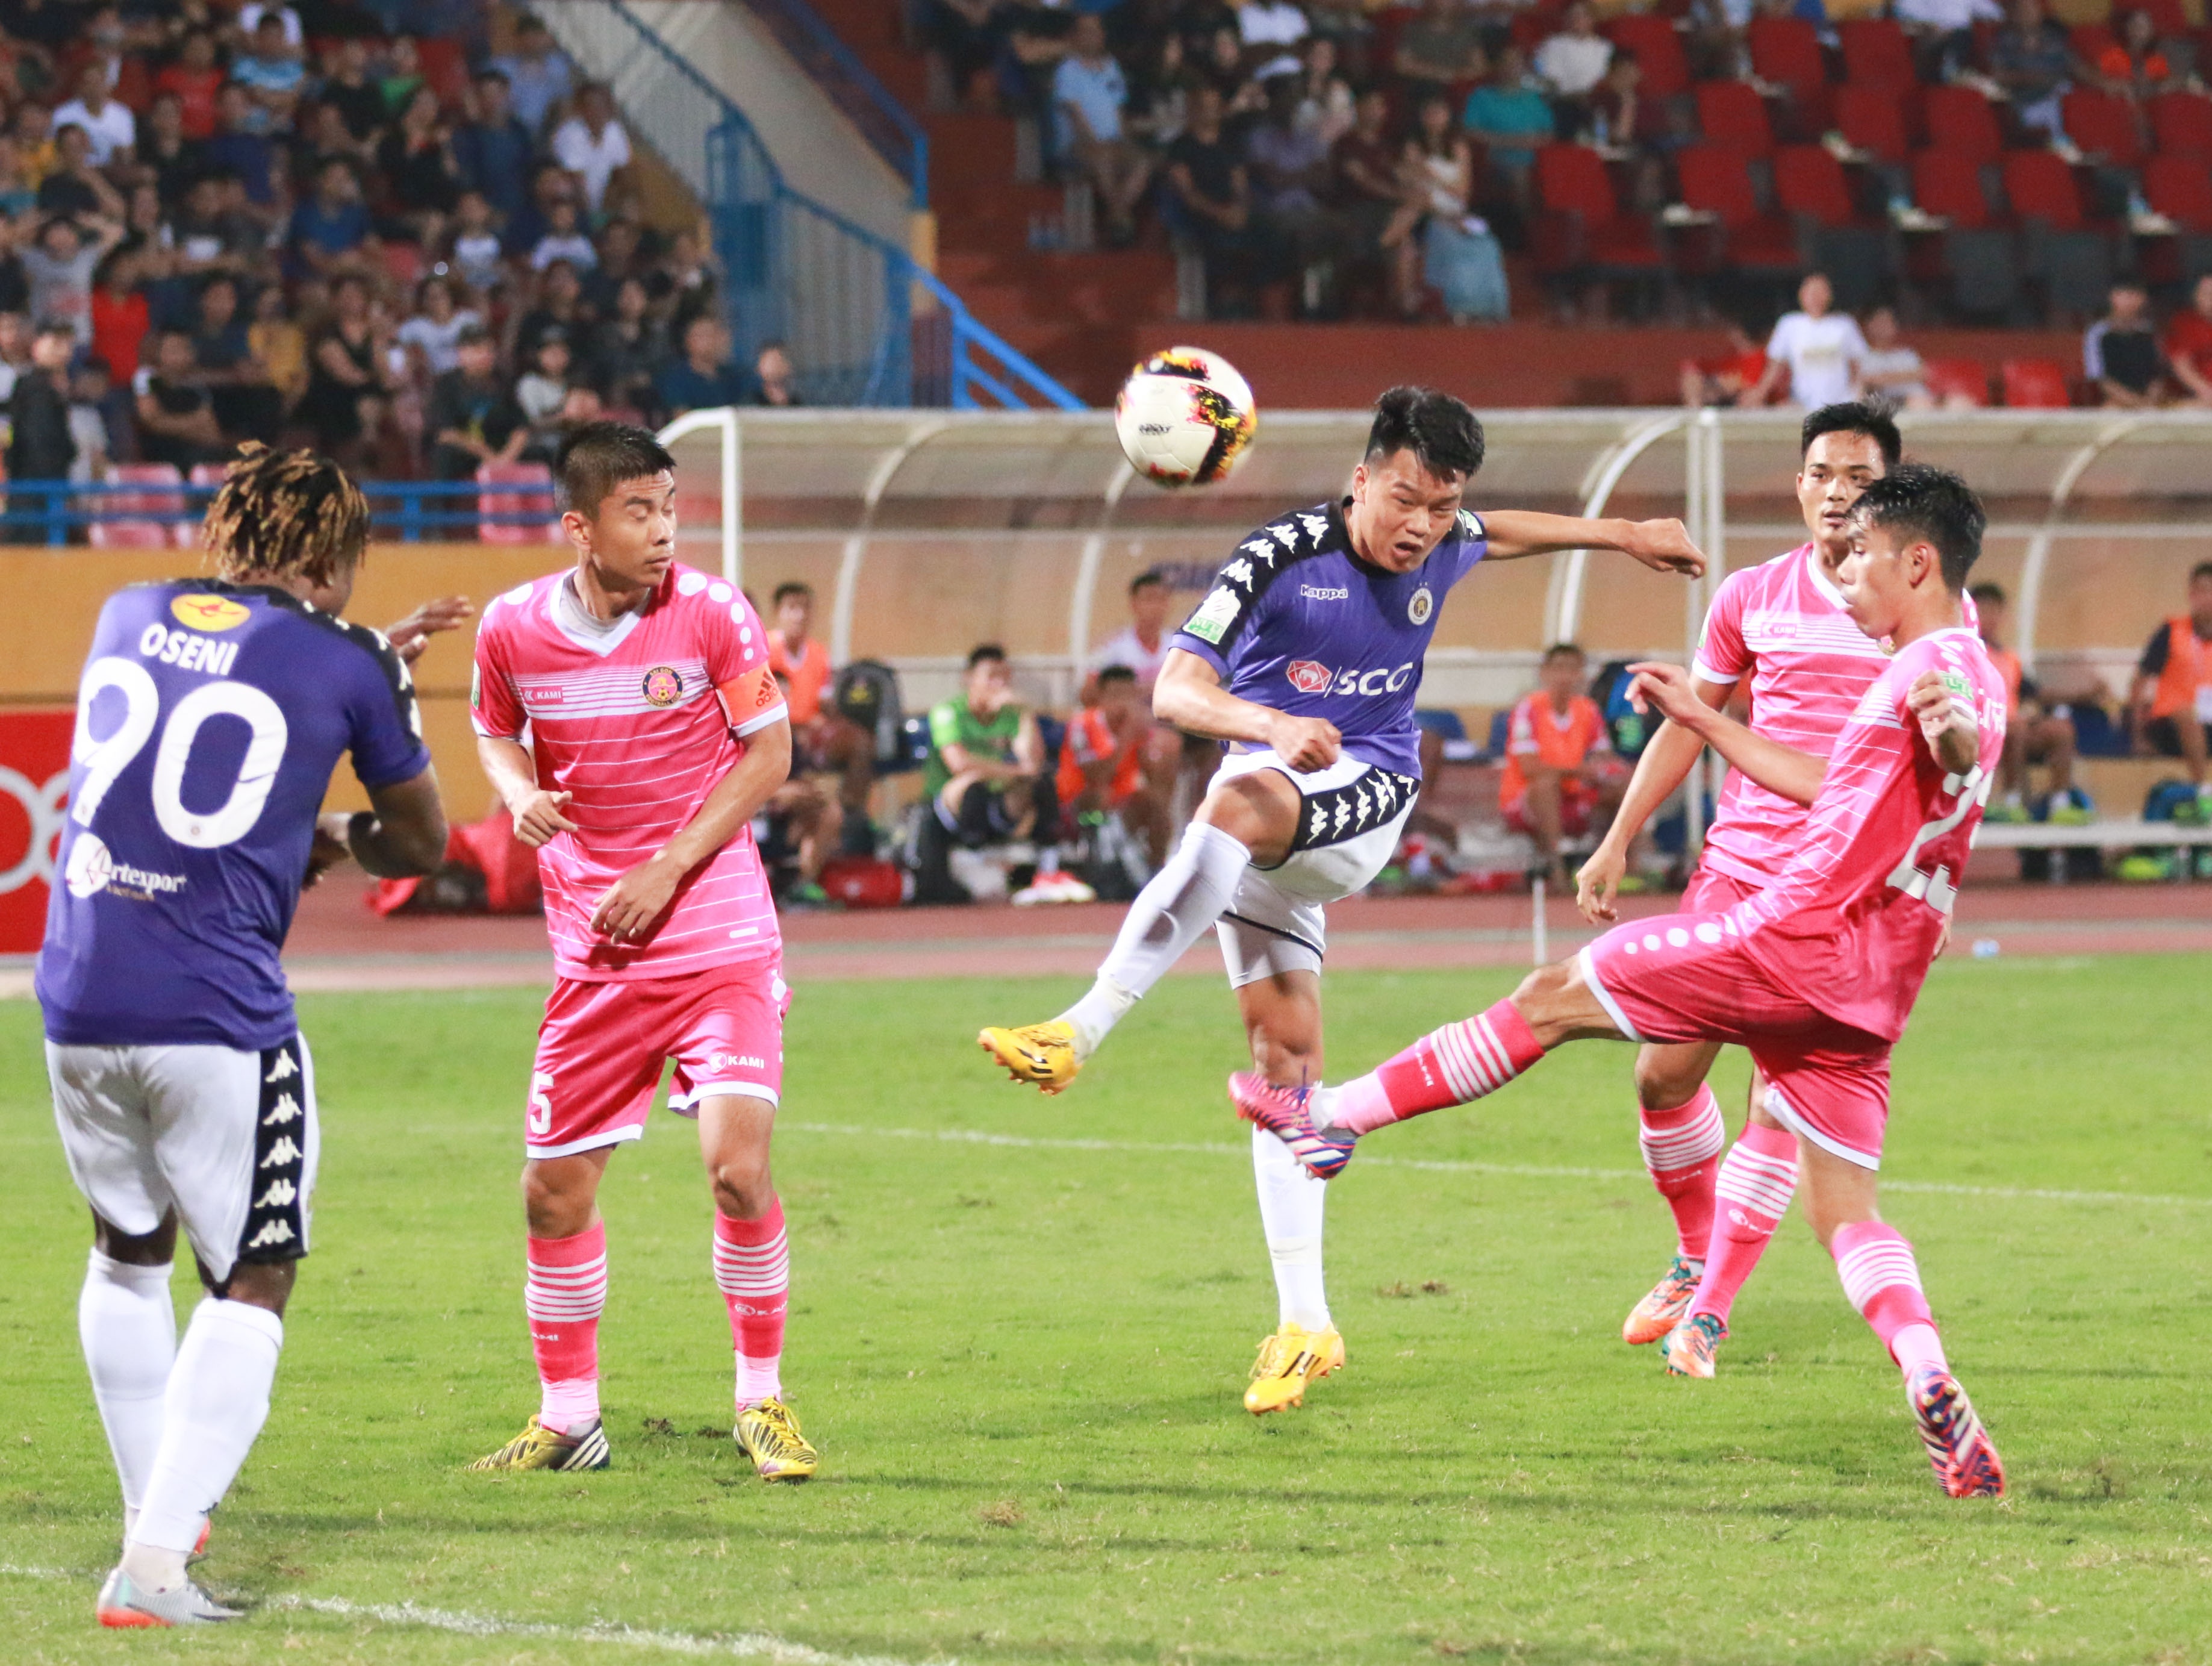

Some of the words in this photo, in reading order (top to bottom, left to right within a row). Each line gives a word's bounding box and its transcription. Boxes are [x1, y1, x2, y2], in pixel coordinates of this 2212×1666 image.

[1301, 584, 1348, 601] Kappa
[140, 623, 239, 676] OSENI
[537, 690, 562, 699] KAMI
[71, 656, 288, 849] 90
[727, 1055, 764, 1069] KAMI
[529, 1070, 554, 1135] 5
